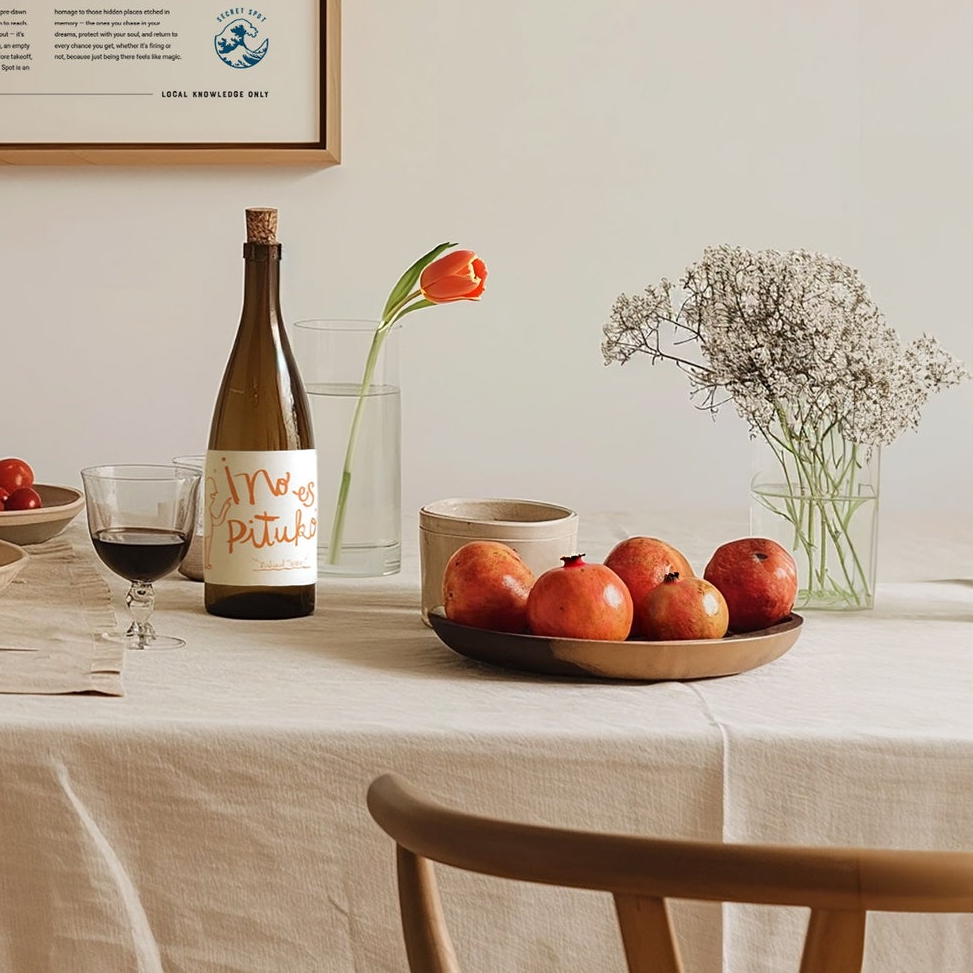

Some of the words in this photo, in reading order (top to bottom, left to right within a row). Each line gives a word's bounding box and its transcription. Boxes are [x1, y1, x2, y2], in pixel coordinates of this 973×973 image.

[216, 7, 244, 23] SECRET
[248, 8, 267, 23] SPOT
[149, 42, 164, 50] firing
[1, 64, 15, 72] Spot
[161, 90, 188, 98] LOCAL
[192, 90, 244, 98] KNOWLEDGE
[248, 90, 269, 98] ONLY
